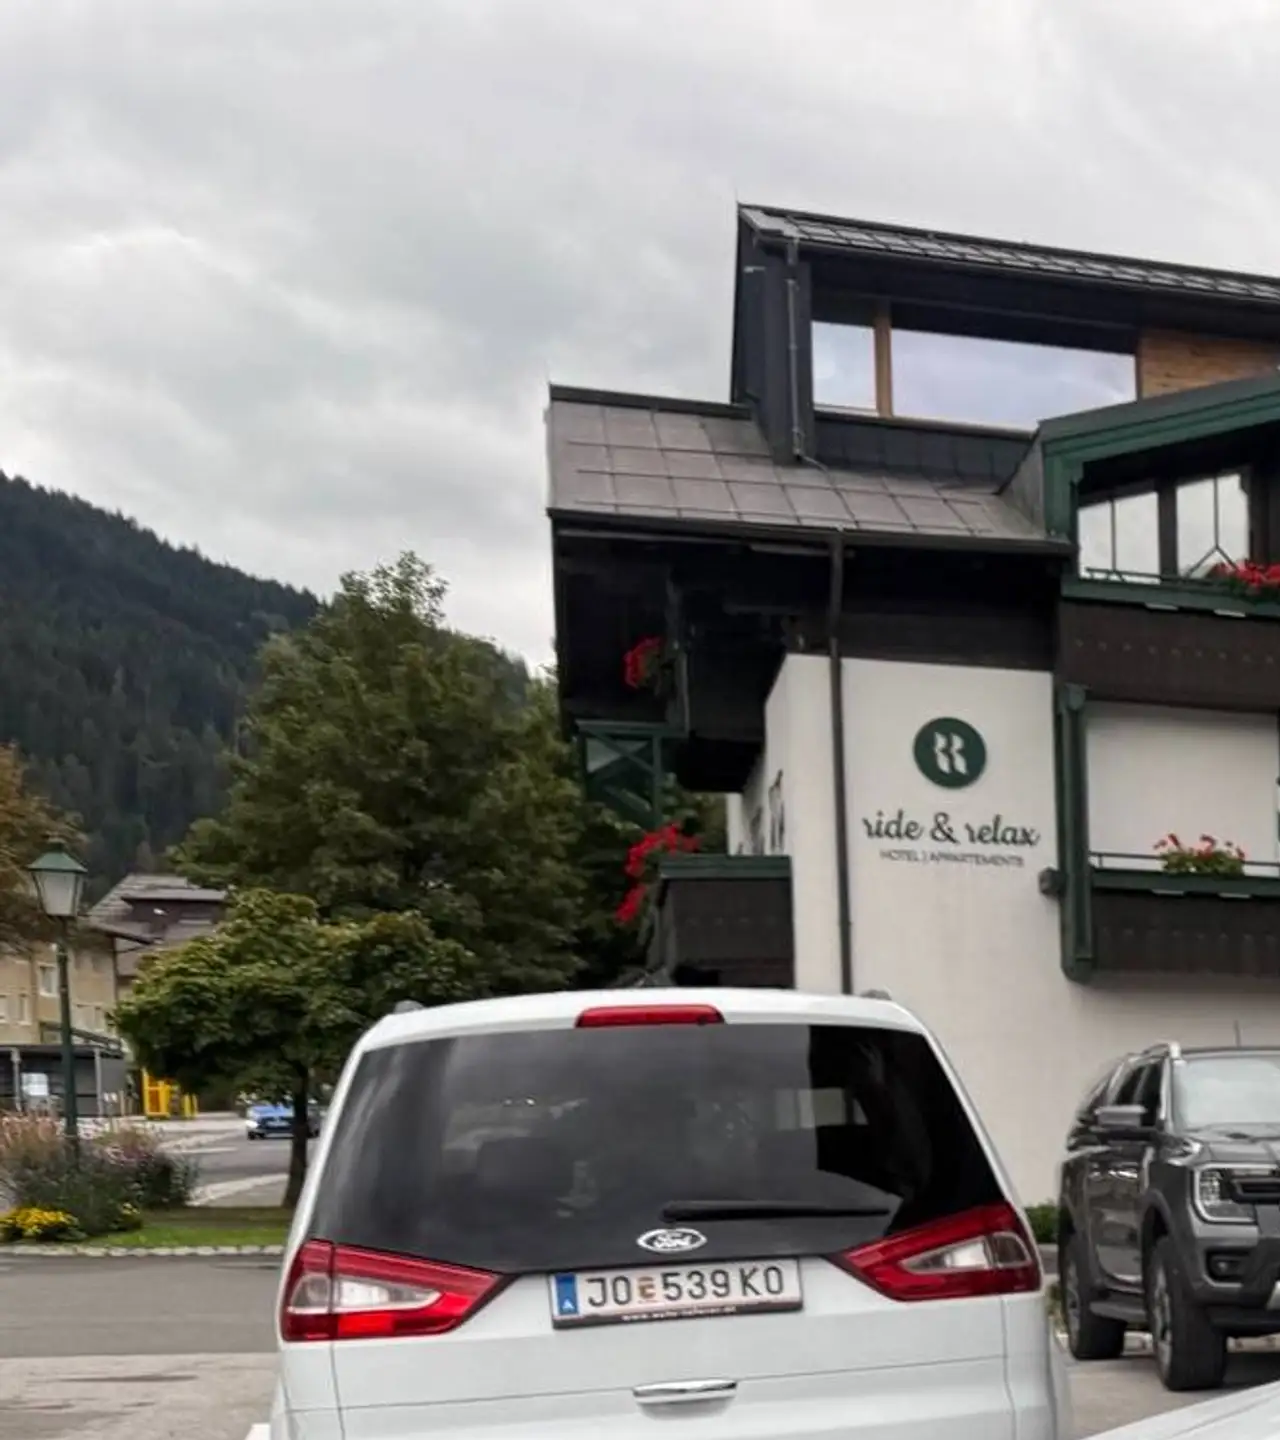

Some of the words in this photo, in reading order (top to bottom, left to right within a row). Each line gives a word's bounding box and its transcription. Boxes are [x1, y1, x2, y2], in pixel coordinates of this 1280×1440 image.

[862, 808, 924, 841] ride
[929, 811, 961, 845] &
[965, 813, 1041, 847] relax
[879, 849, 920, 862] HOTEL
[586, 1275, 632, 1308] JO
[660, 1269, 731, 1302] 539
[739, 1265, 785, 1297] KO
